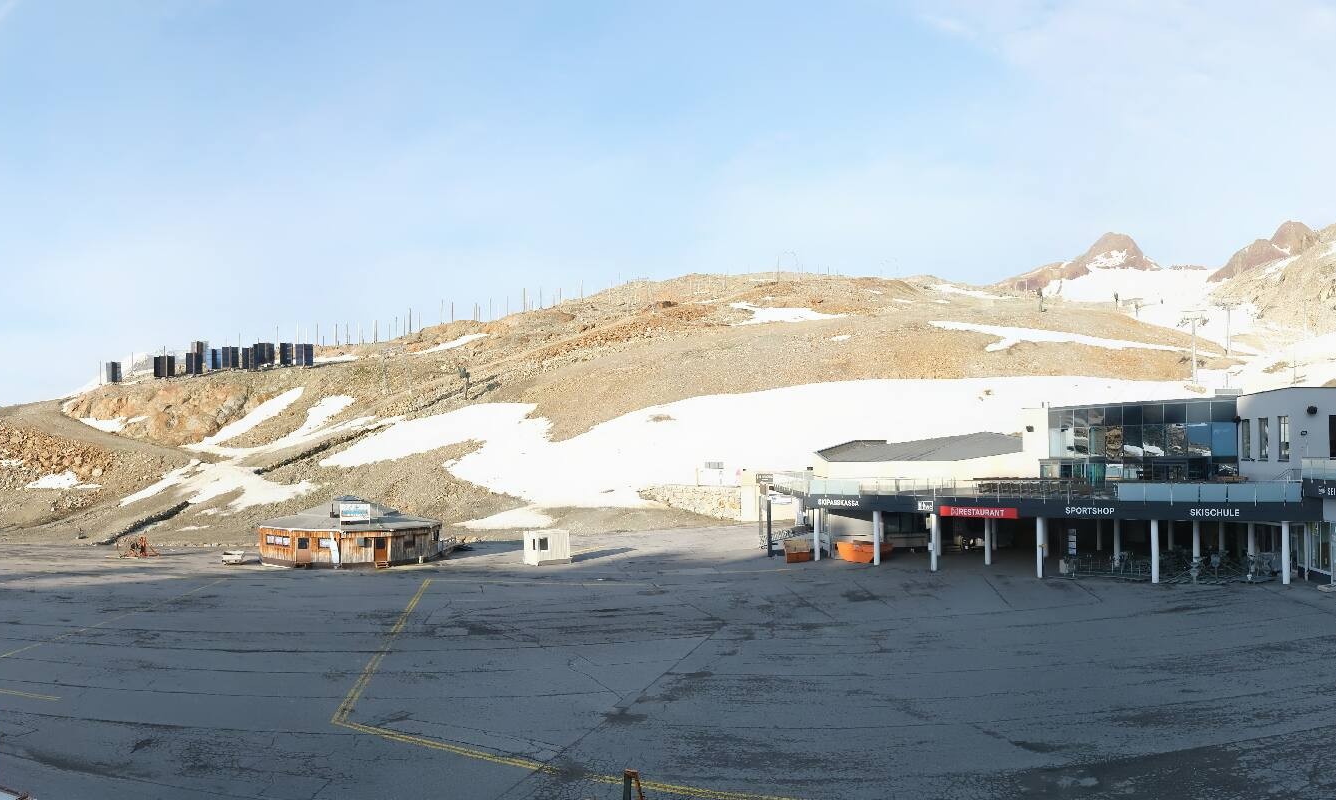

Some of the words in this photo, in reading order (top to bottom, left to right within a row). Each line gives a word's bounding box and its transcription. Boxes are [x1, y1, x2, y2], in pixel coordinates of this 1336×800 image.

[958, 508, 1005, 517] RESTAURANT
[1065, 506, 1115, 515] SPORTSHOP
[1190, 508, 1240, 517] SKISCHULE
